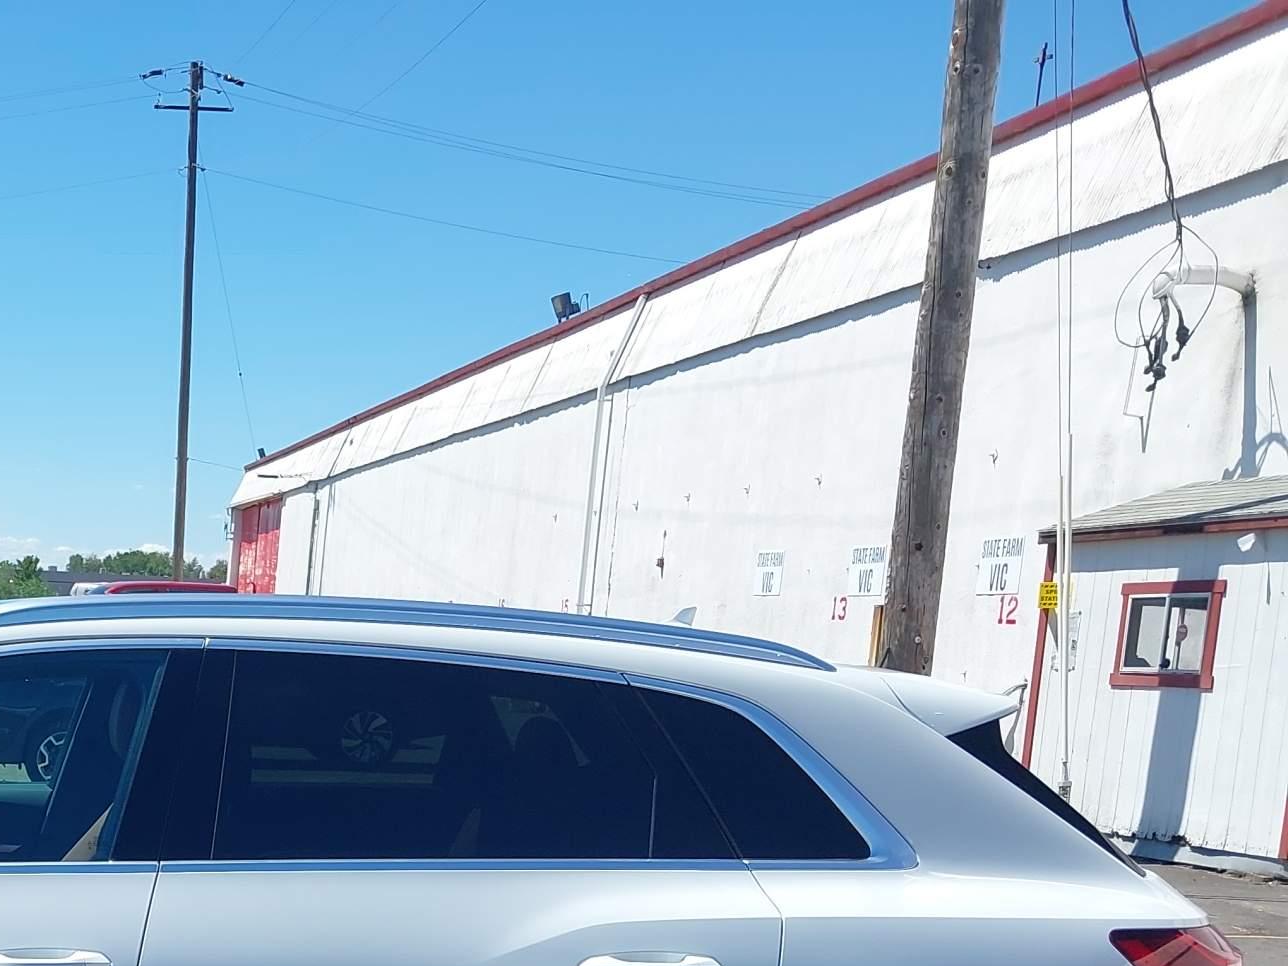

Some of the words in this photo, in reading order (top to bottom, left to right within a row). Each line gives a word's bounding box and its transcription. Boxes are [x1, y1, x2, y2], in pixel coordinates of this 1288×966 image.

[851, 547, 869, 565] STATE
[869, 546, 886, 563] FARM
[981, 539, 1002, 559] STATE
[1002, 537, 1024, 557] FARM
[762, 571, 774, 593] VIC
[858, 569, 873, 593] VIC
[989, 563, 1008, 592] VIC
[831, 596, 848, 621] 13
[998, 595, 1019, 624] 12
